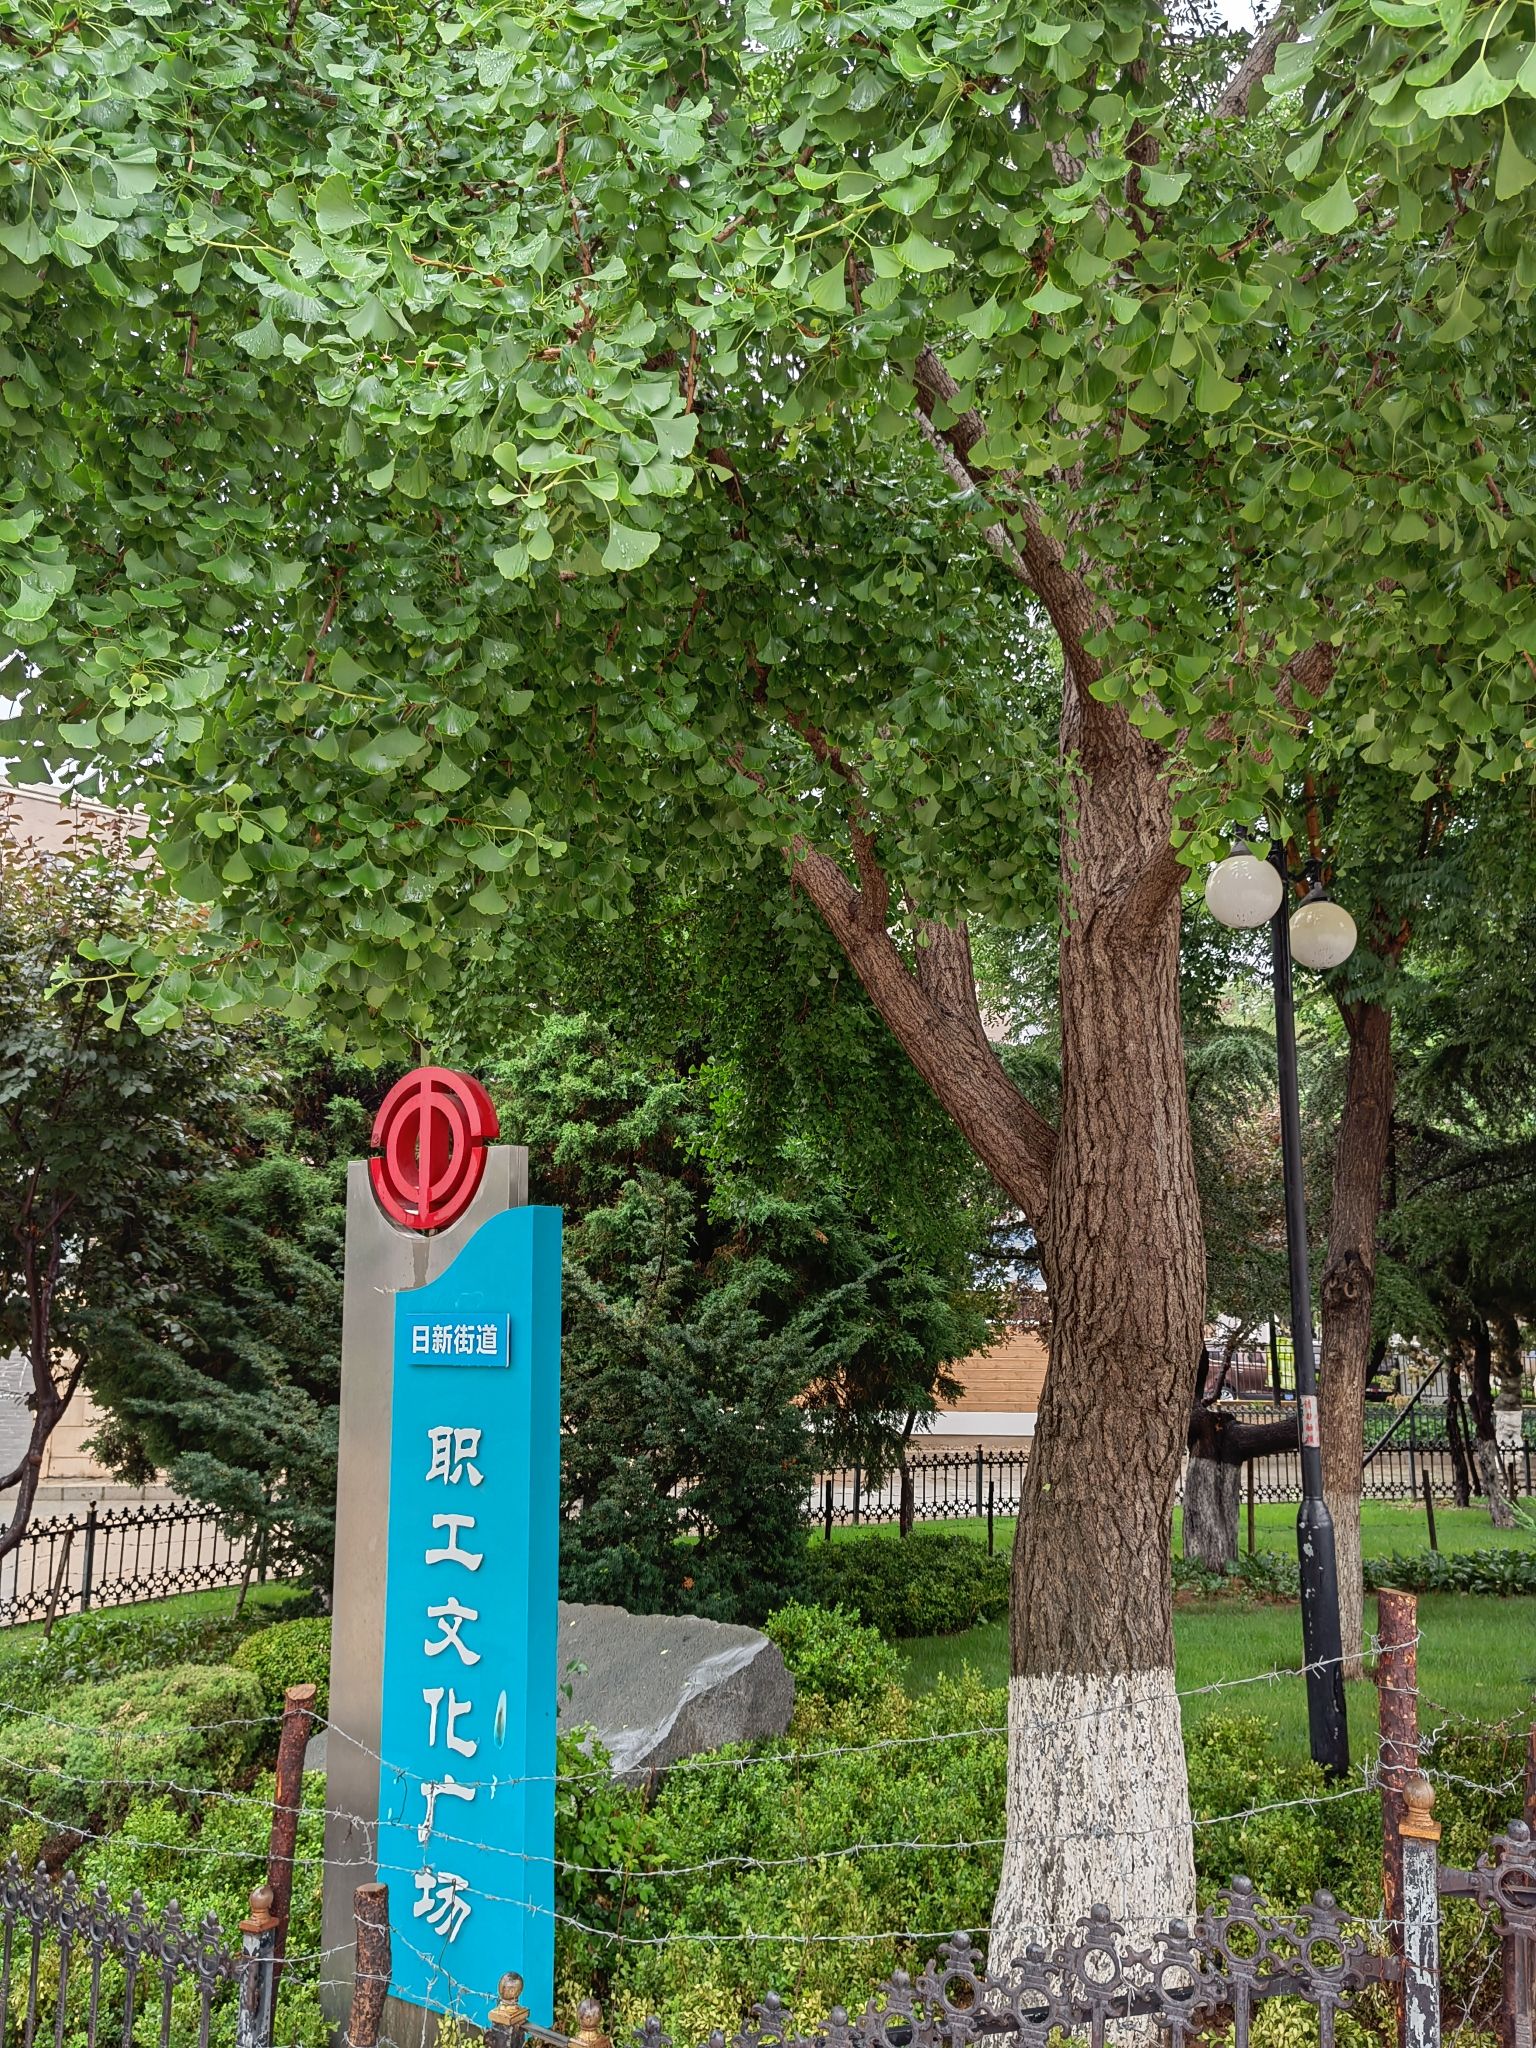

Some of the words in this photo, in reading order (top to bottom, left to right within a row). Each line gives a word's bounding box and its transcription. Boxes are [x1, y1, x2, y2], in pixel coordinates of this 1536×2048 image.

[412, 1324, 498, 1354] 日新街道
[413, 1425, 484, 1943] 职工文化广场
